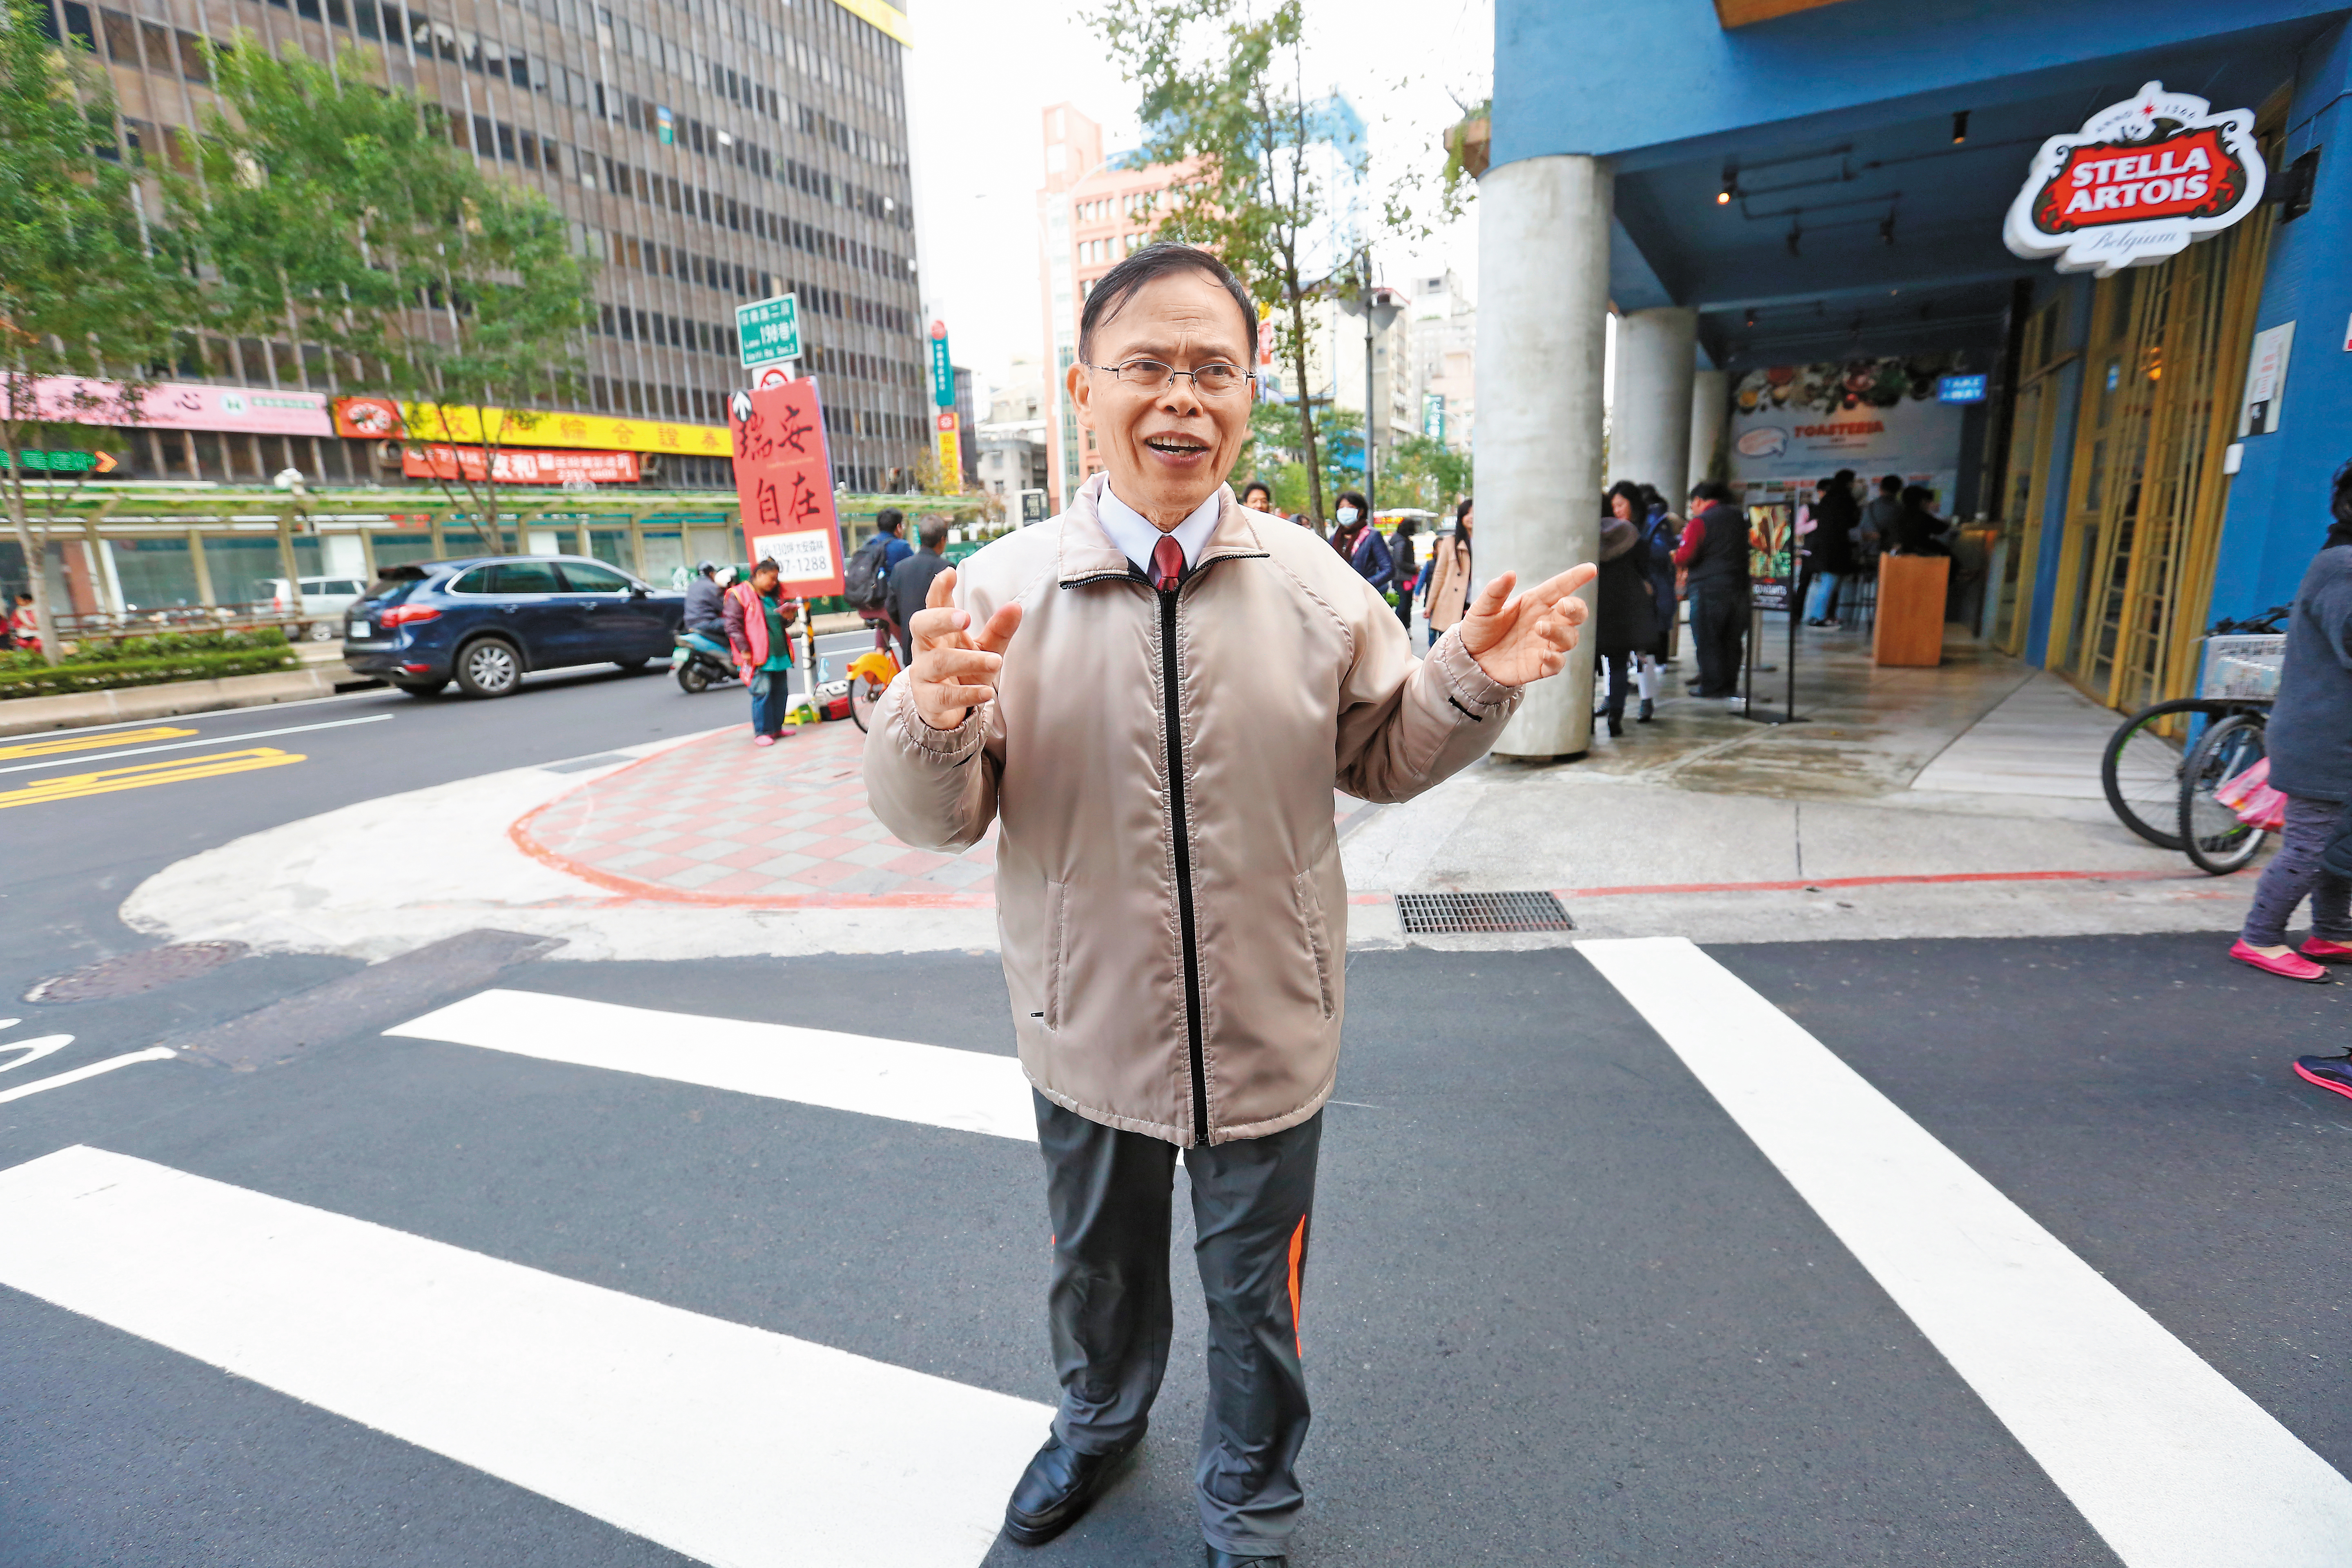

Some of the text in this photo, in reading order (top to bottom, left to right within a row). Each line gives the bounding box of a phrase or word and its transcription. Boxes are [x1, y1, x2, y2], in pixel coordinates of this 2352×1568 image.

[2071, 146, 2212, 188] STELLA
[2064, 174, 2209, 215] ARTOIS
[2088, 229, 2178, 254] Belgium
[756, 471, 820, 526] 自在
[777, 555, 826, 573] 07-1288
